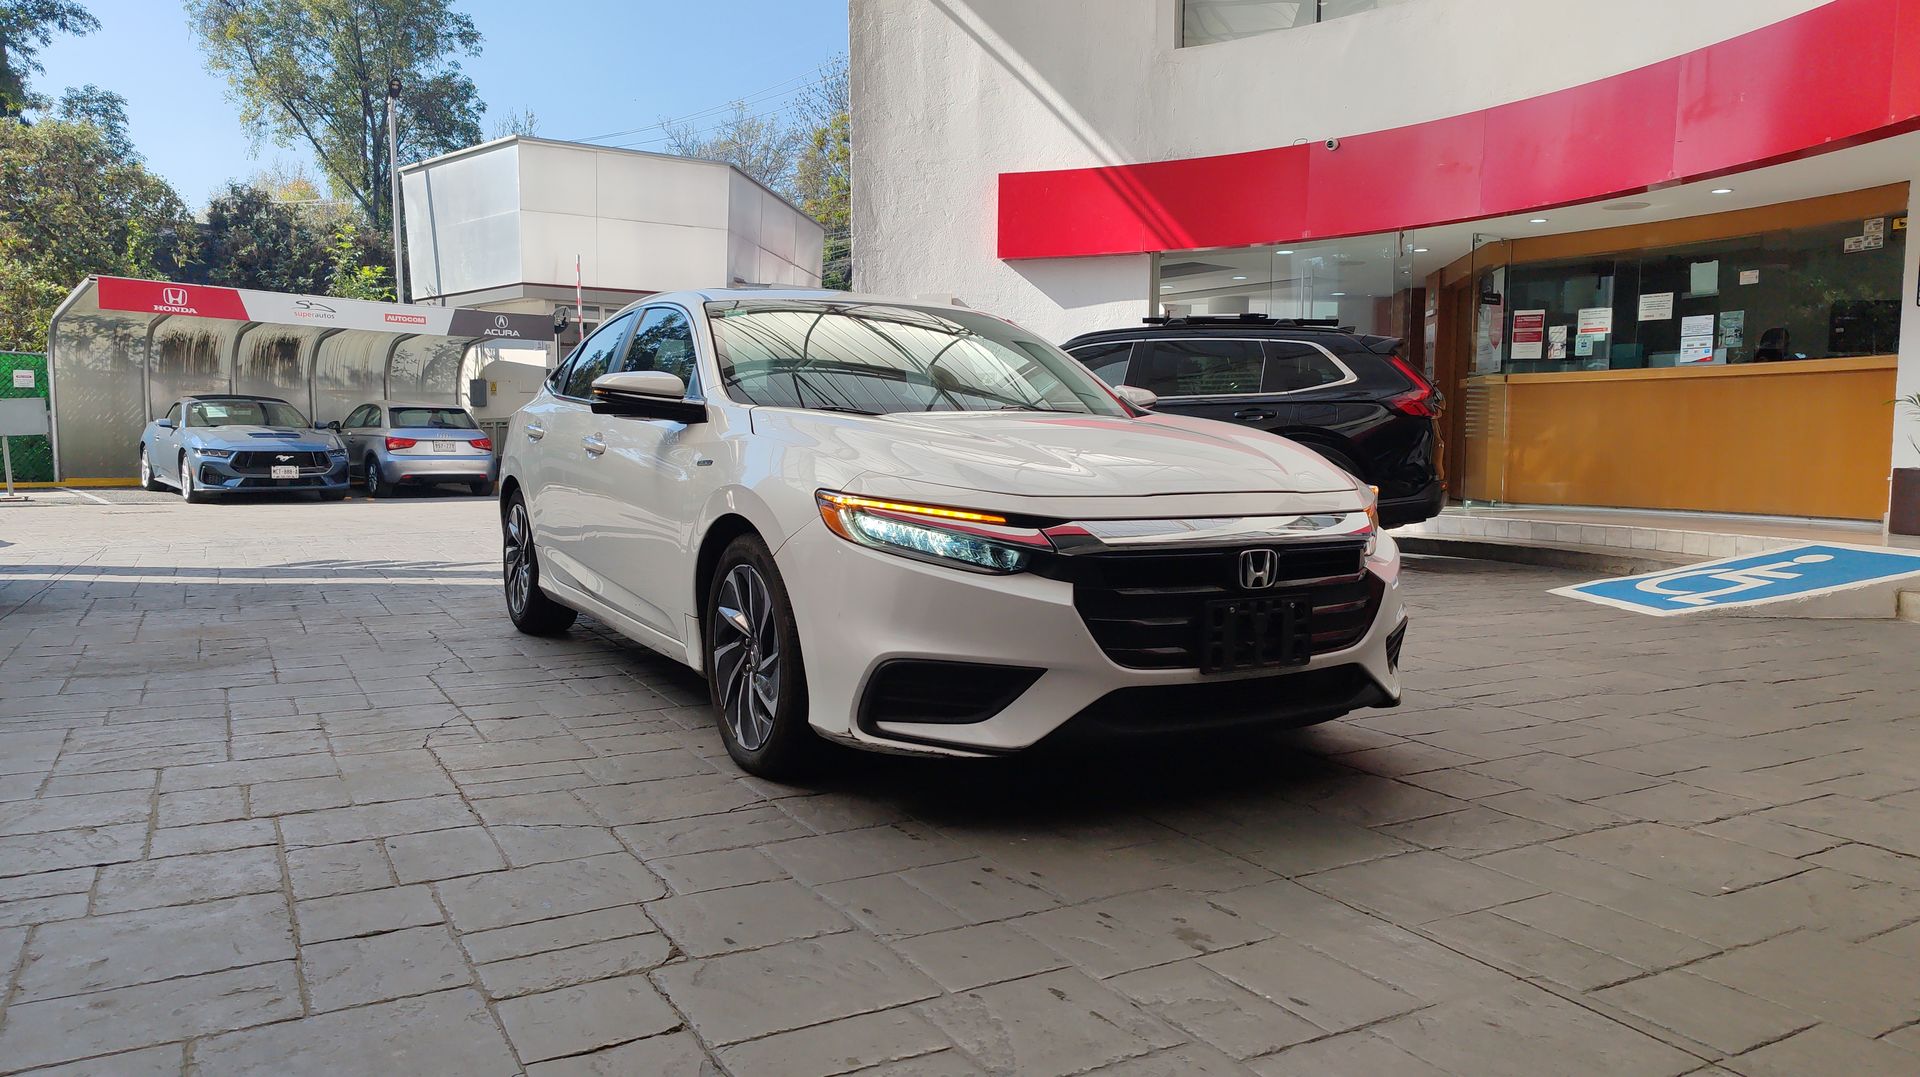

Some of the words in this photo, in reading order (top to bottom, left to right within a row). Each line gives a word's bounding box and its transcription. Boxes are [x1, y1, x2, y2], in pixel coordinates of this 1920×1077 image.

[153, 305, 198, 314] HONDA
[294, 311, 335, 319] superautos
[387, 315, 425, 323] AUTOCOM
[484, 328, 520, 337] ACURA
